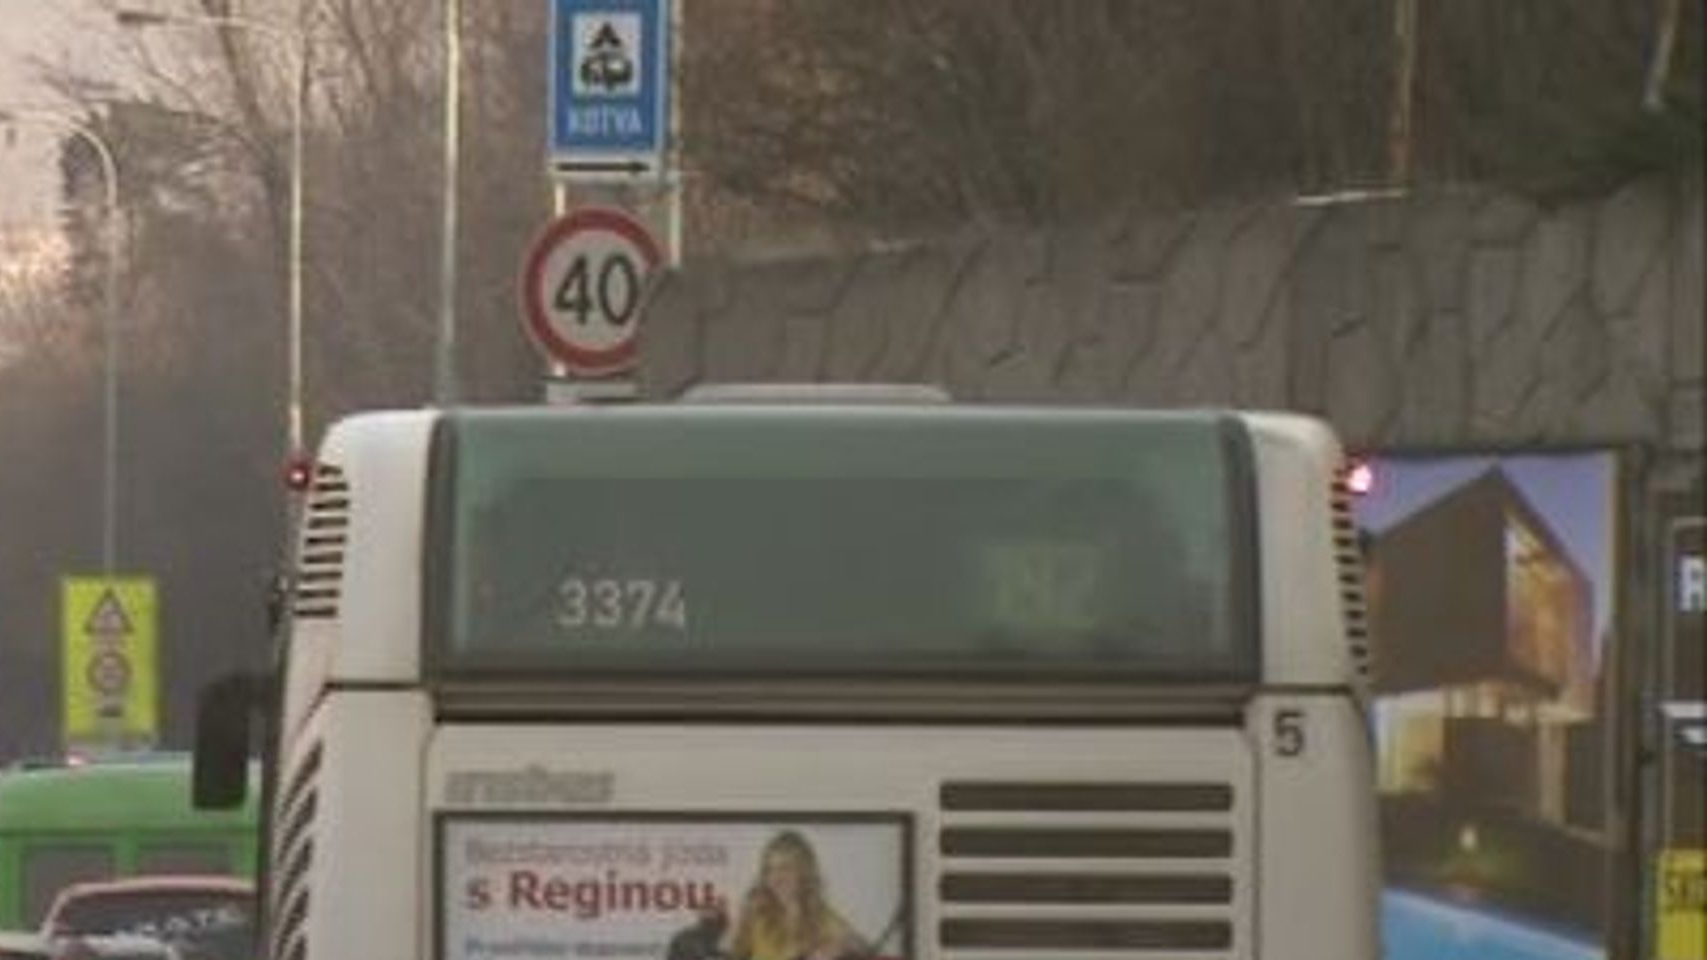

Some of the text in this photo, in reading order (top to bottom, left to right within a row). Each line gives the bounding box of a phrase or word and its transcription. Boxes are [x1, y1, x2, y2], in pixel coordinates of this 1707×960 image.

[566, 106, 643, 137] KOTVA
[554, 254, 639, 326] 40
[557, 578, 686, 629] 3374
[1274, 709, 1305, 757] 5
[464, 877, 492, 910] s
